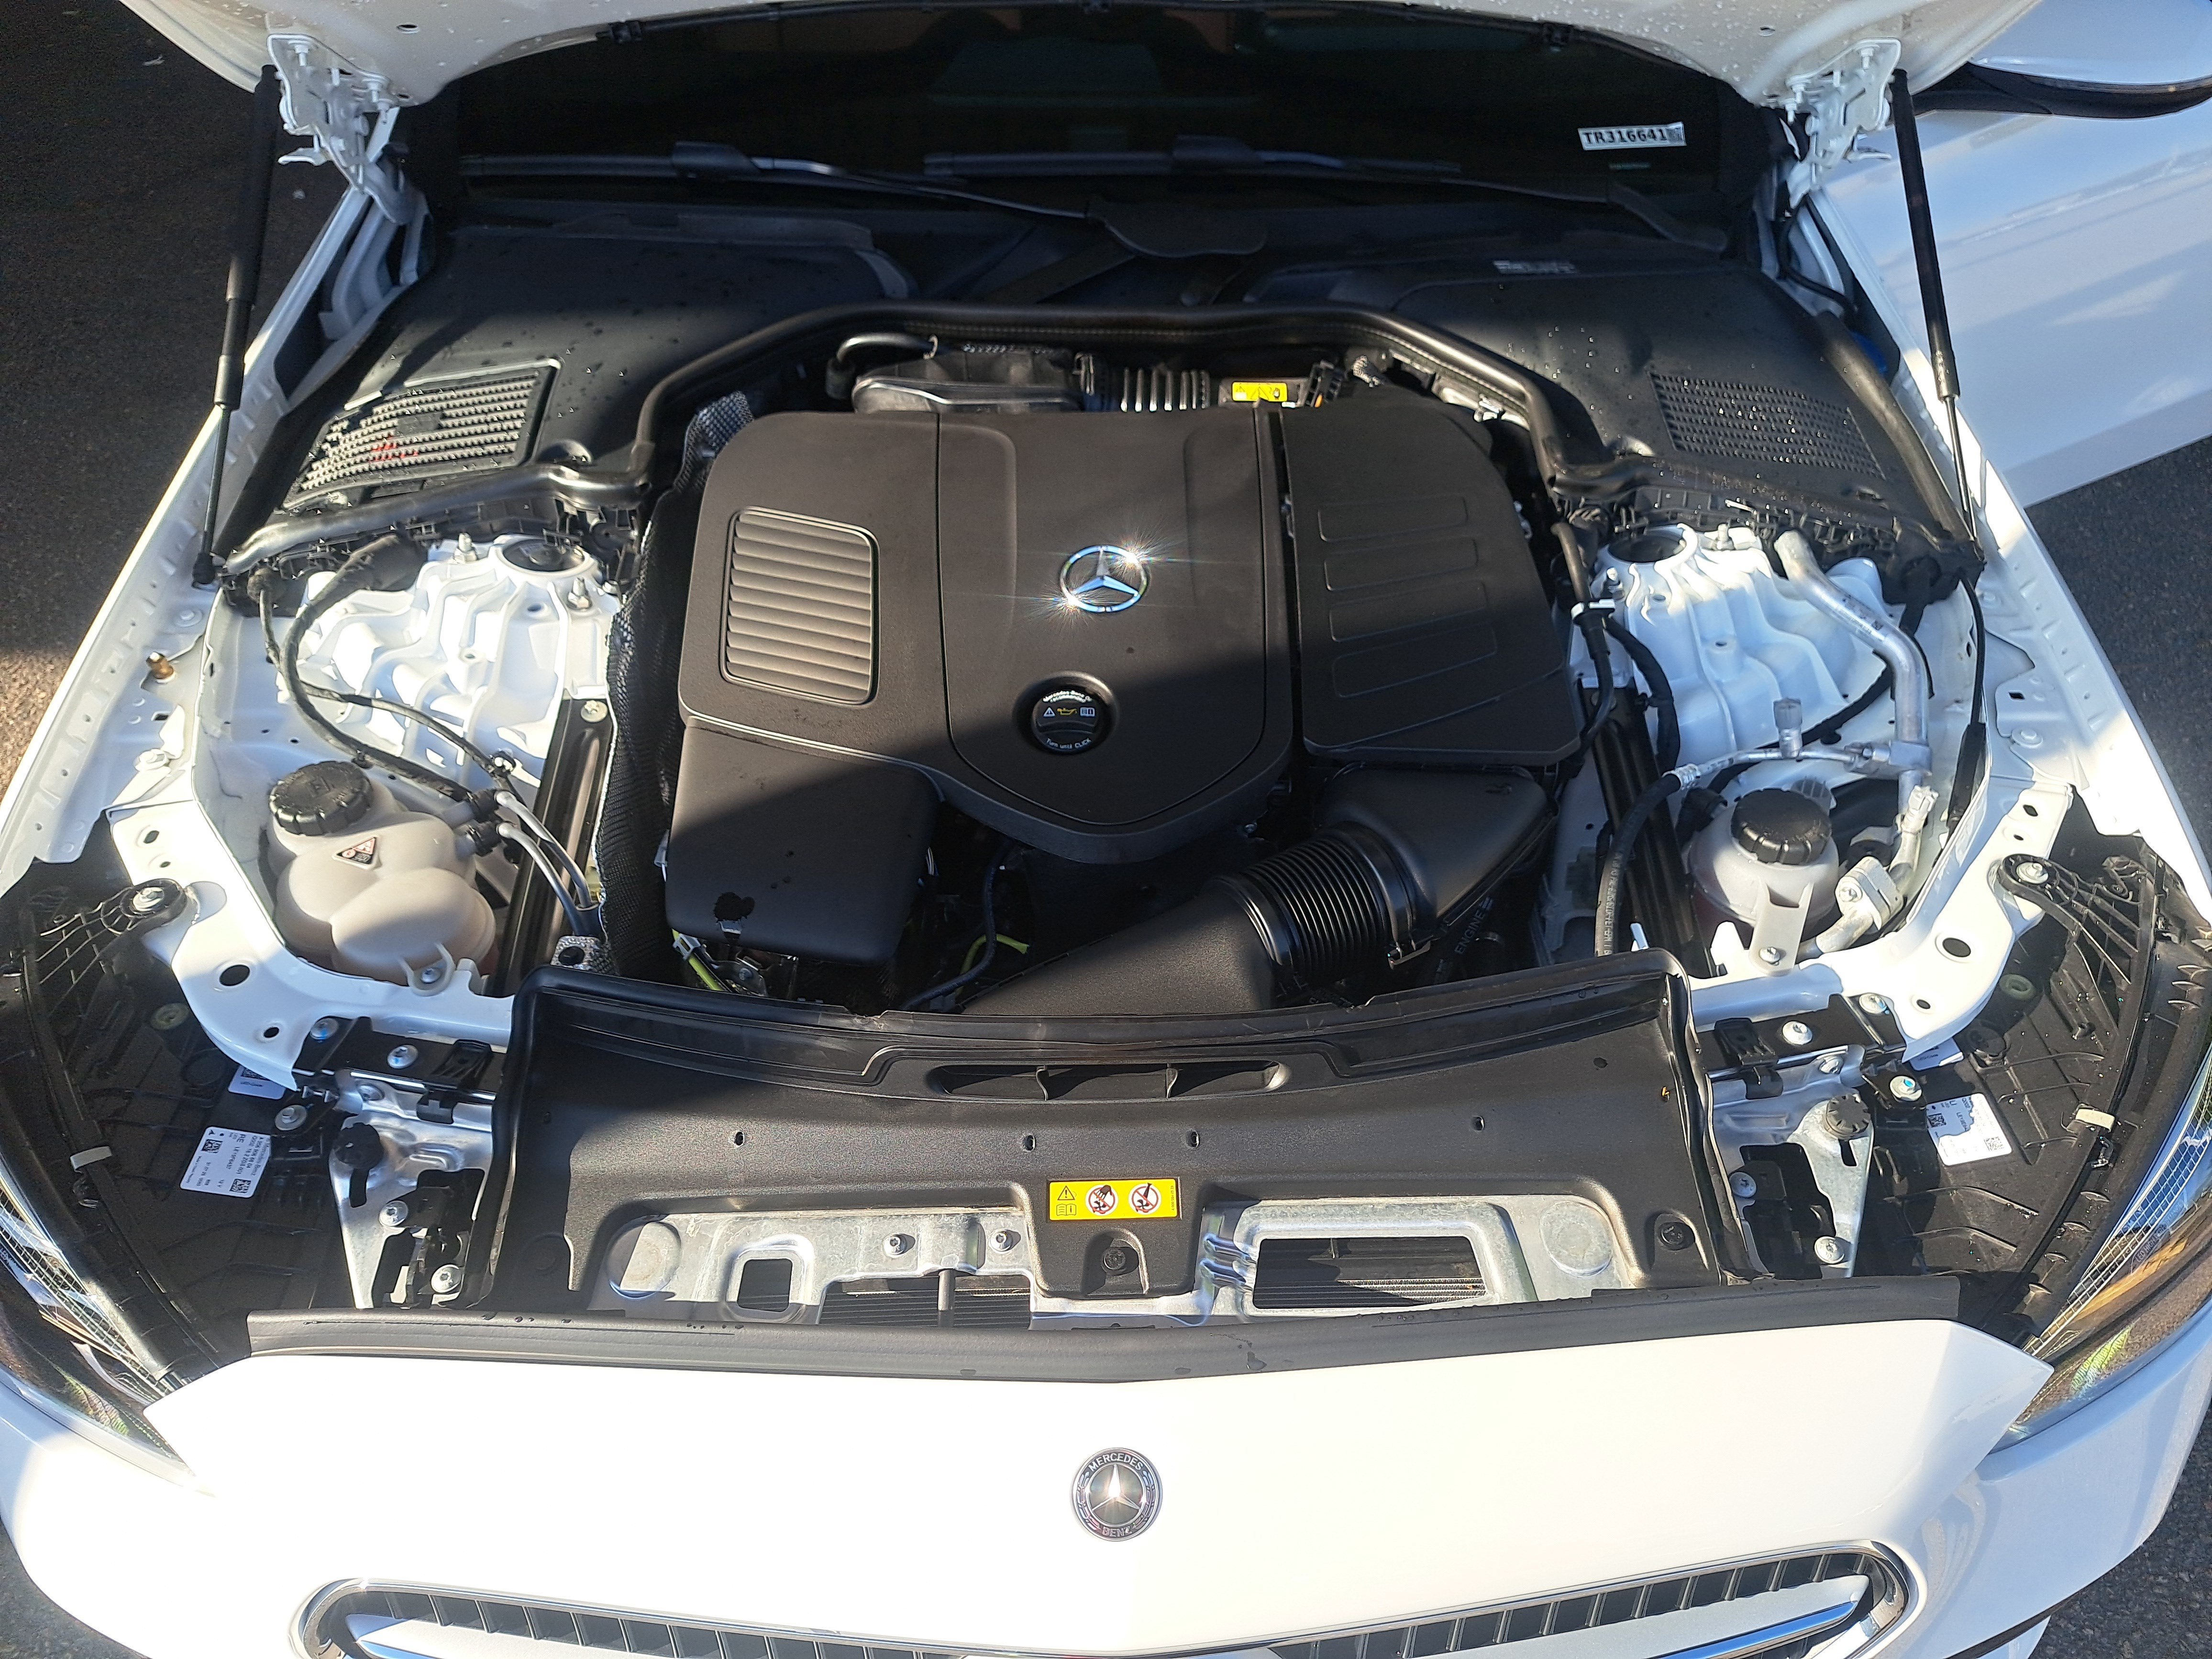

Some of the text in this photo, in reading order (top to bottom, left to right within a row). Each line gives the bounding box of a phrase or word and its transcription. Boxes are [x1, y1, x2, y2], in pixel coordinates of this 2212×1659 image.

[1582, 129, 1668, 144] TR316641
[1046, 738, 1058, 748] Turn
[1074, 737, 1092, 749] CLICK
[1454, 909, 1486, 954] ENGINE
[237, 1134, 246, 1143] RE
[2135, 1250, 2146, 1262] LED
[2145, 1239, 2156, 1254] HIGH
[1088, 1453, 1144, 1537] MERCEDES BENZ
